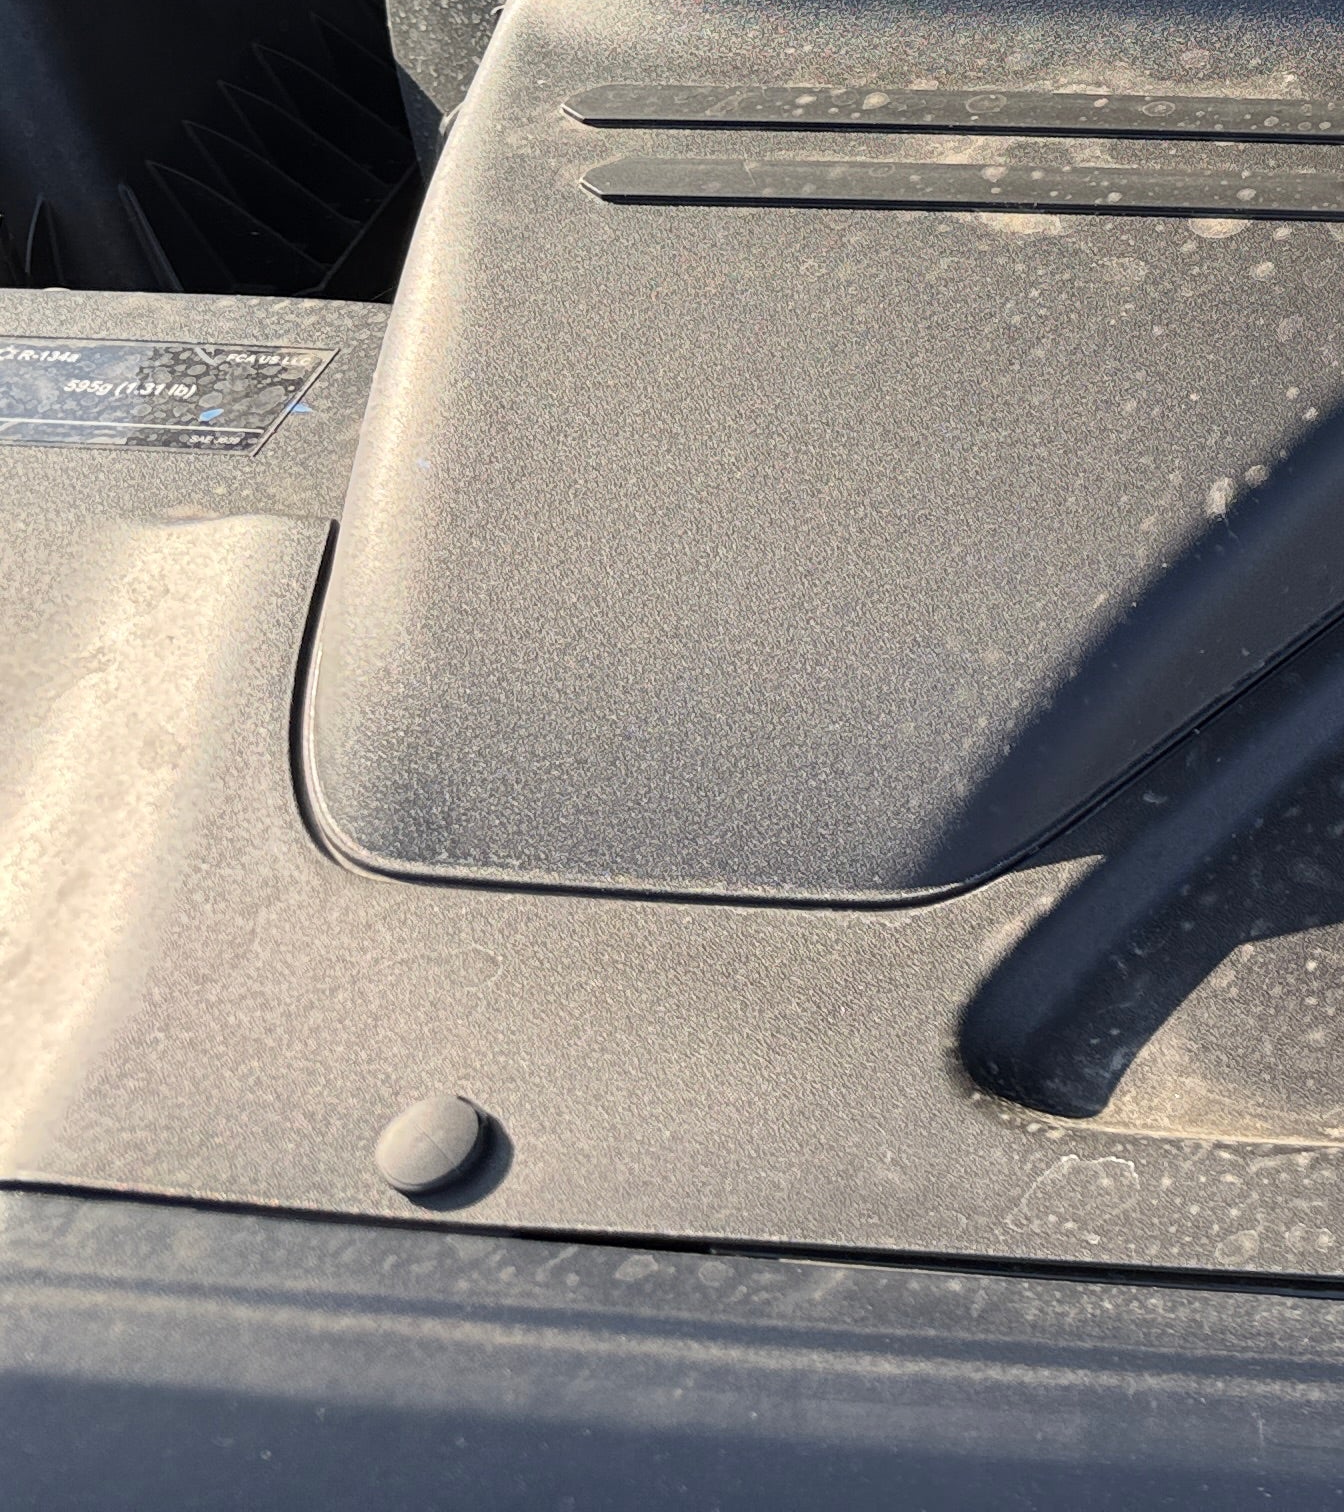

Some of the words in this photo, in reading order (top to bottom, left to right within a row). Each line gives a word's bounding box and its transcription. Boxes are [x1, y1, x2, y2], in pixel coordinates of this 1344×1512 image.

[17, 349, 80, 363] R-134a
[226, 353, 257, 364] FCA
[258, 354, 281, 365] US
[281, 356, 312, 366] LLC
[64, 379, 114, 396] 595g
[114, 381, 167, 398] (1.31
